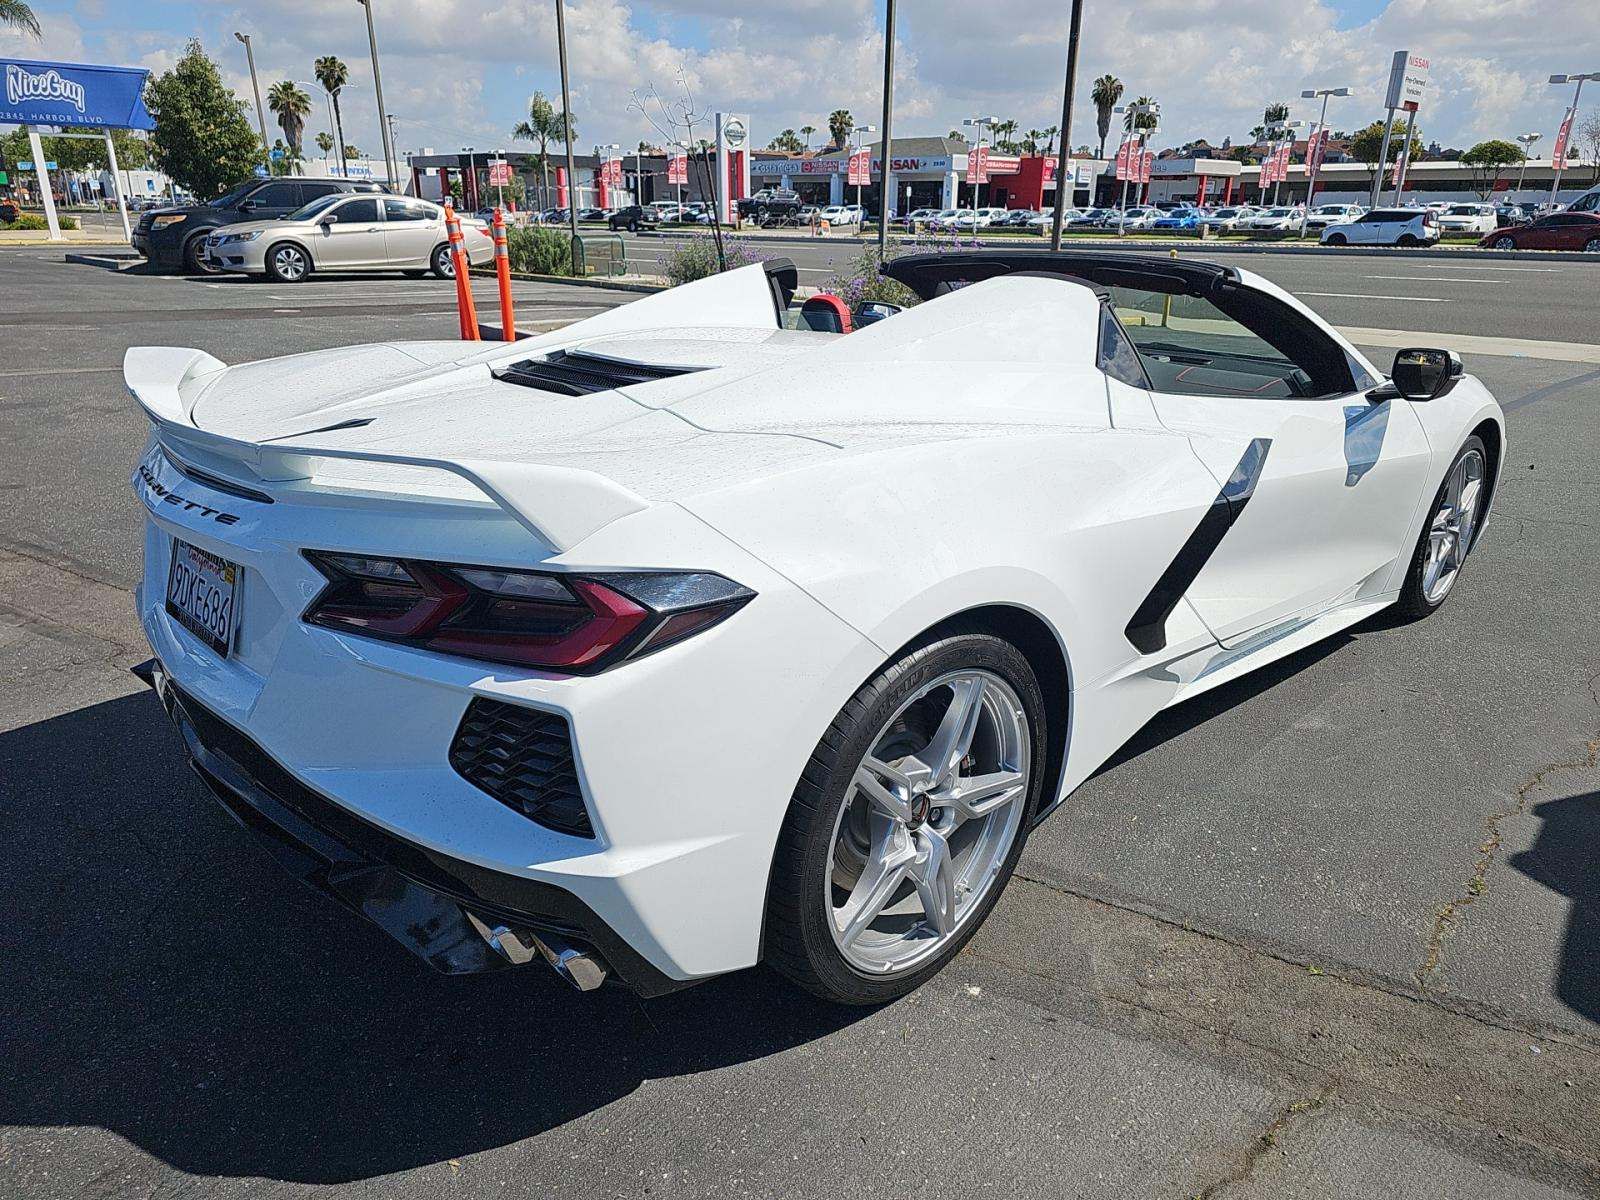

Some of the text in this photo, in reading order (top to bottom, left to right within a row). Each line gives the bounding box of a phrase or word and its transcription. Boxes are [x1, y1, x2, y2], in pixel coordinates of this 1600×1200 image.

[1409, 56, 1429, 69] NISSAN
[31, 114, 72, 122] HARBOR
[873, 158, 919, 170] NSAN
[140, 465, 240, 526] CORVETTE
[172, 562, 230, 639] 9DKE686
